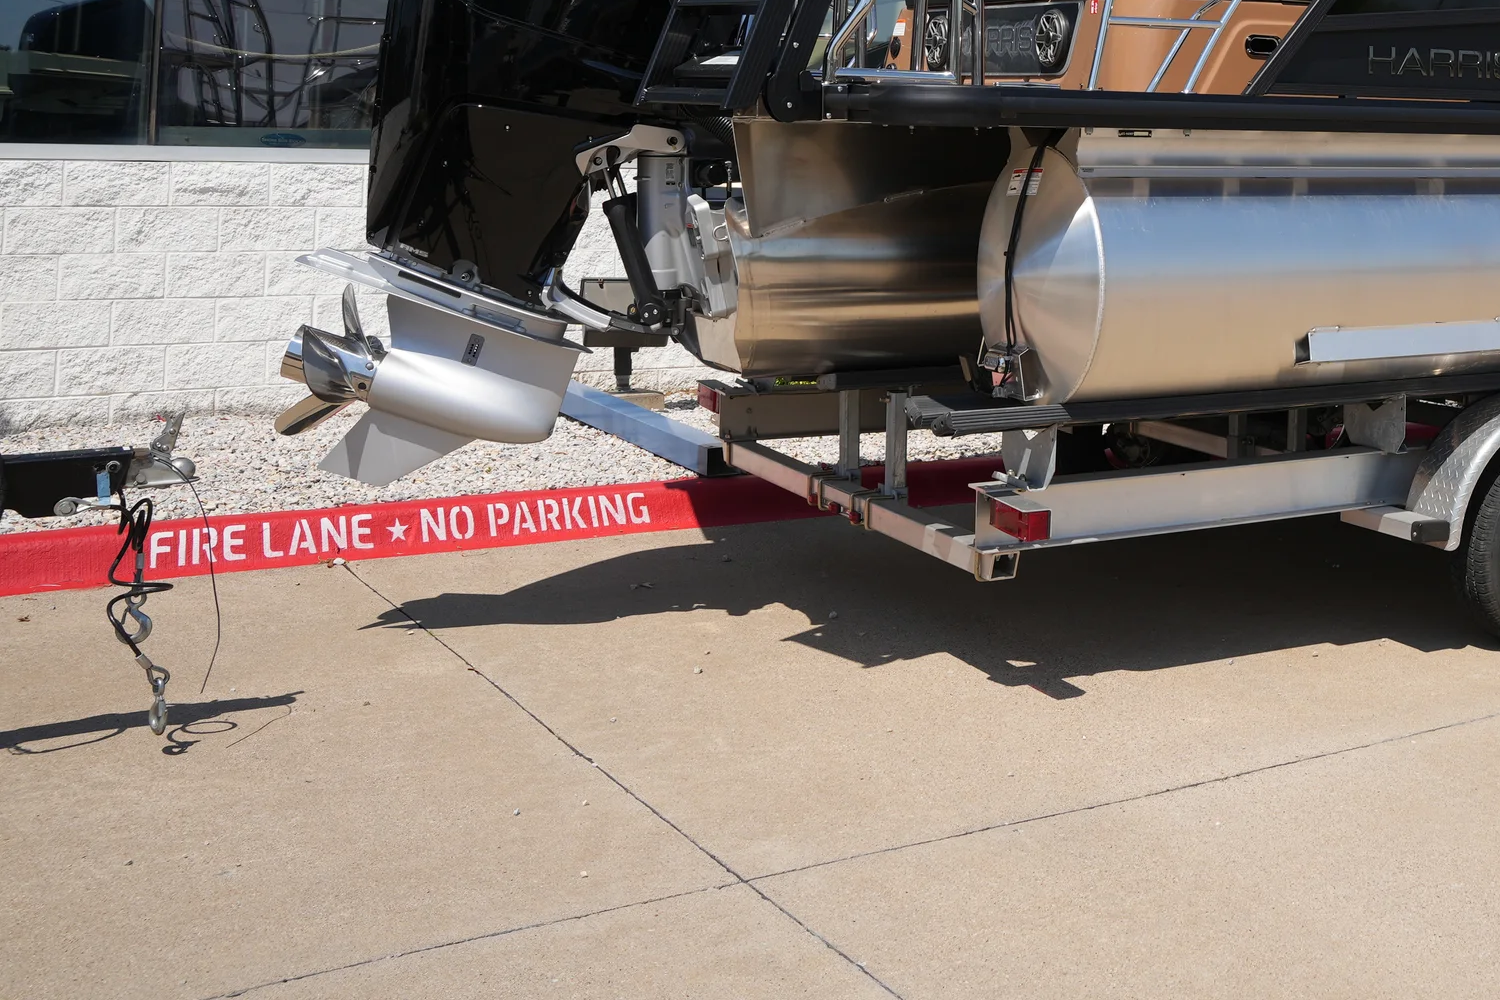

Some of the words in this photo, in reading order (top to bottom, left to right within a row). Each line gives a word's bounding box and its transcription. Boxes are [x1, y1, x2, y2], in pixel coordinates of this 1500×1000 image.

[150, 524, 246, 568] FIRE
[262, 513, 374, 558] LANE
[420, 505, 475, 542] NO
[487, 492, 651, 537] PARKING
